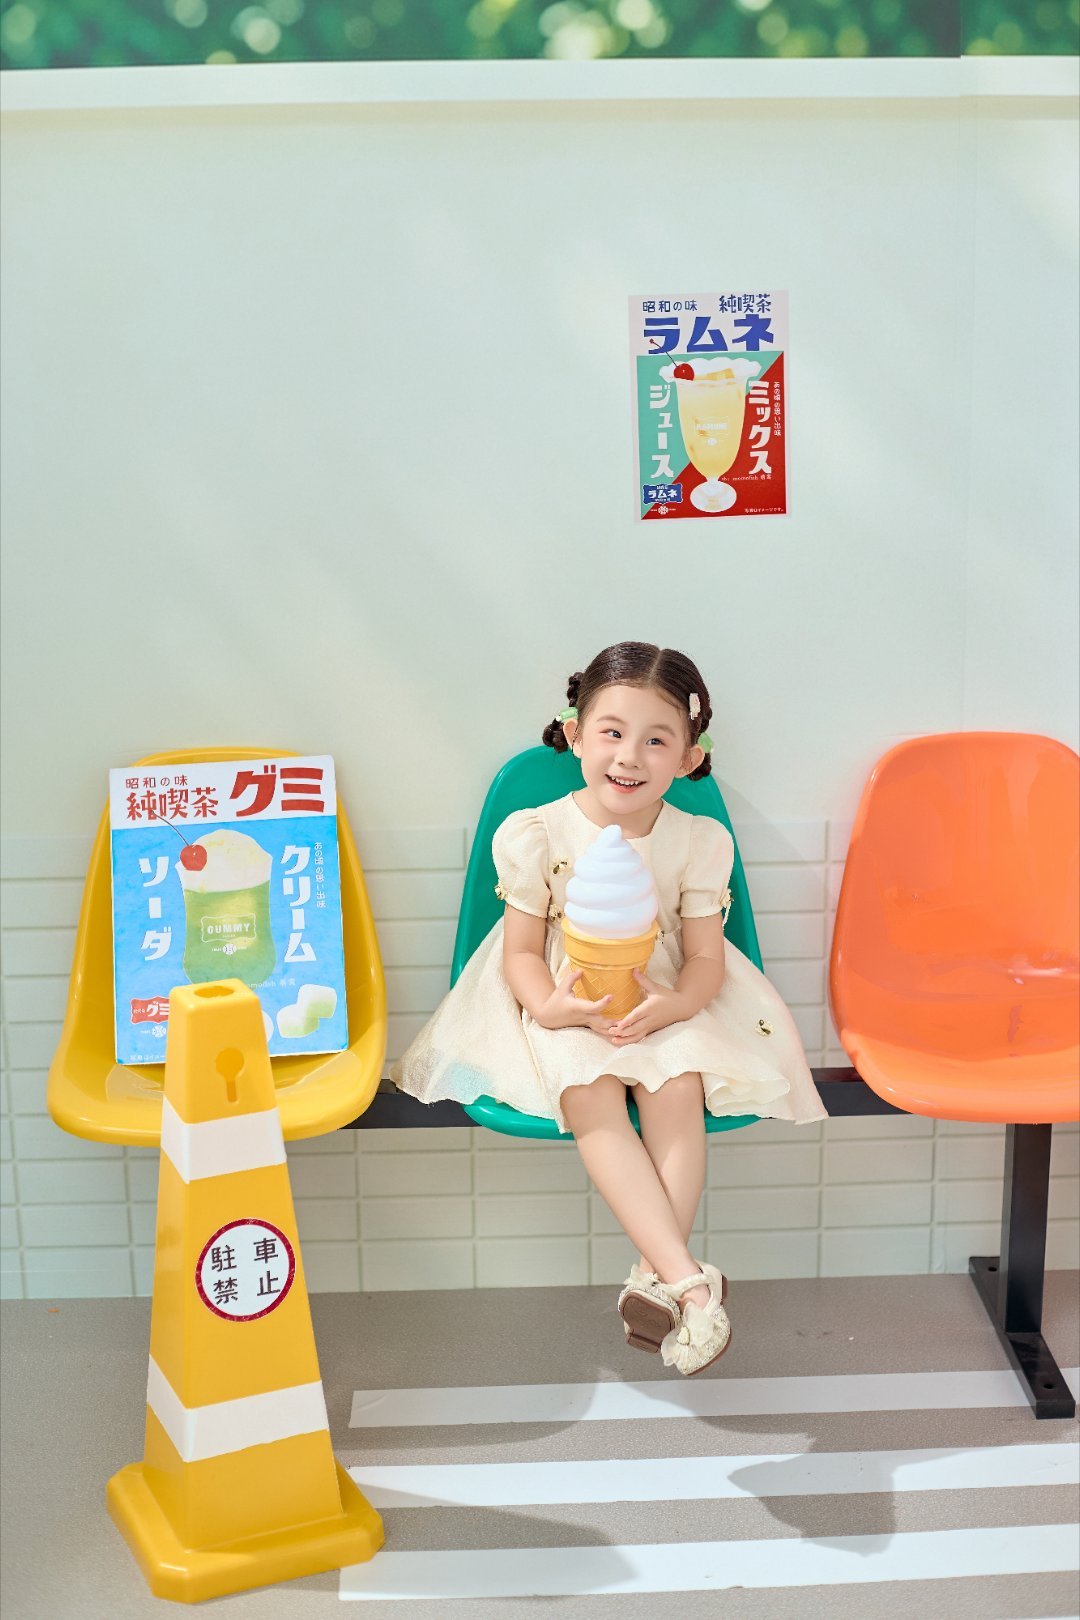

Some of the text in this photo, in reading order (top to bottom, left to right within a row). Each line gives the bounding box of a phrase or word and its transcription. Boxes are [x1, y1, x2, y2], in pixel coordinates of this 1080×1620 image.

[643, 293, 771, 313] 昭和の味 純喫茶
[643, 314, 774, 355] ラムネ
[649, 384, 674, 479] ジュース
[748, 380, 772, 475] ミックス
[648, 489, 677, 499] ラムネ
[125, 775, 188, 789] 昭和の味
[229, 765, 325, 817] グミ
[126, 787, 219, 821] 純喫茶
[138, 856, 172, 961] ソーダ
[280, 845, 317, 963] クリーム
[207, 922, 250, 935] GUMMY
